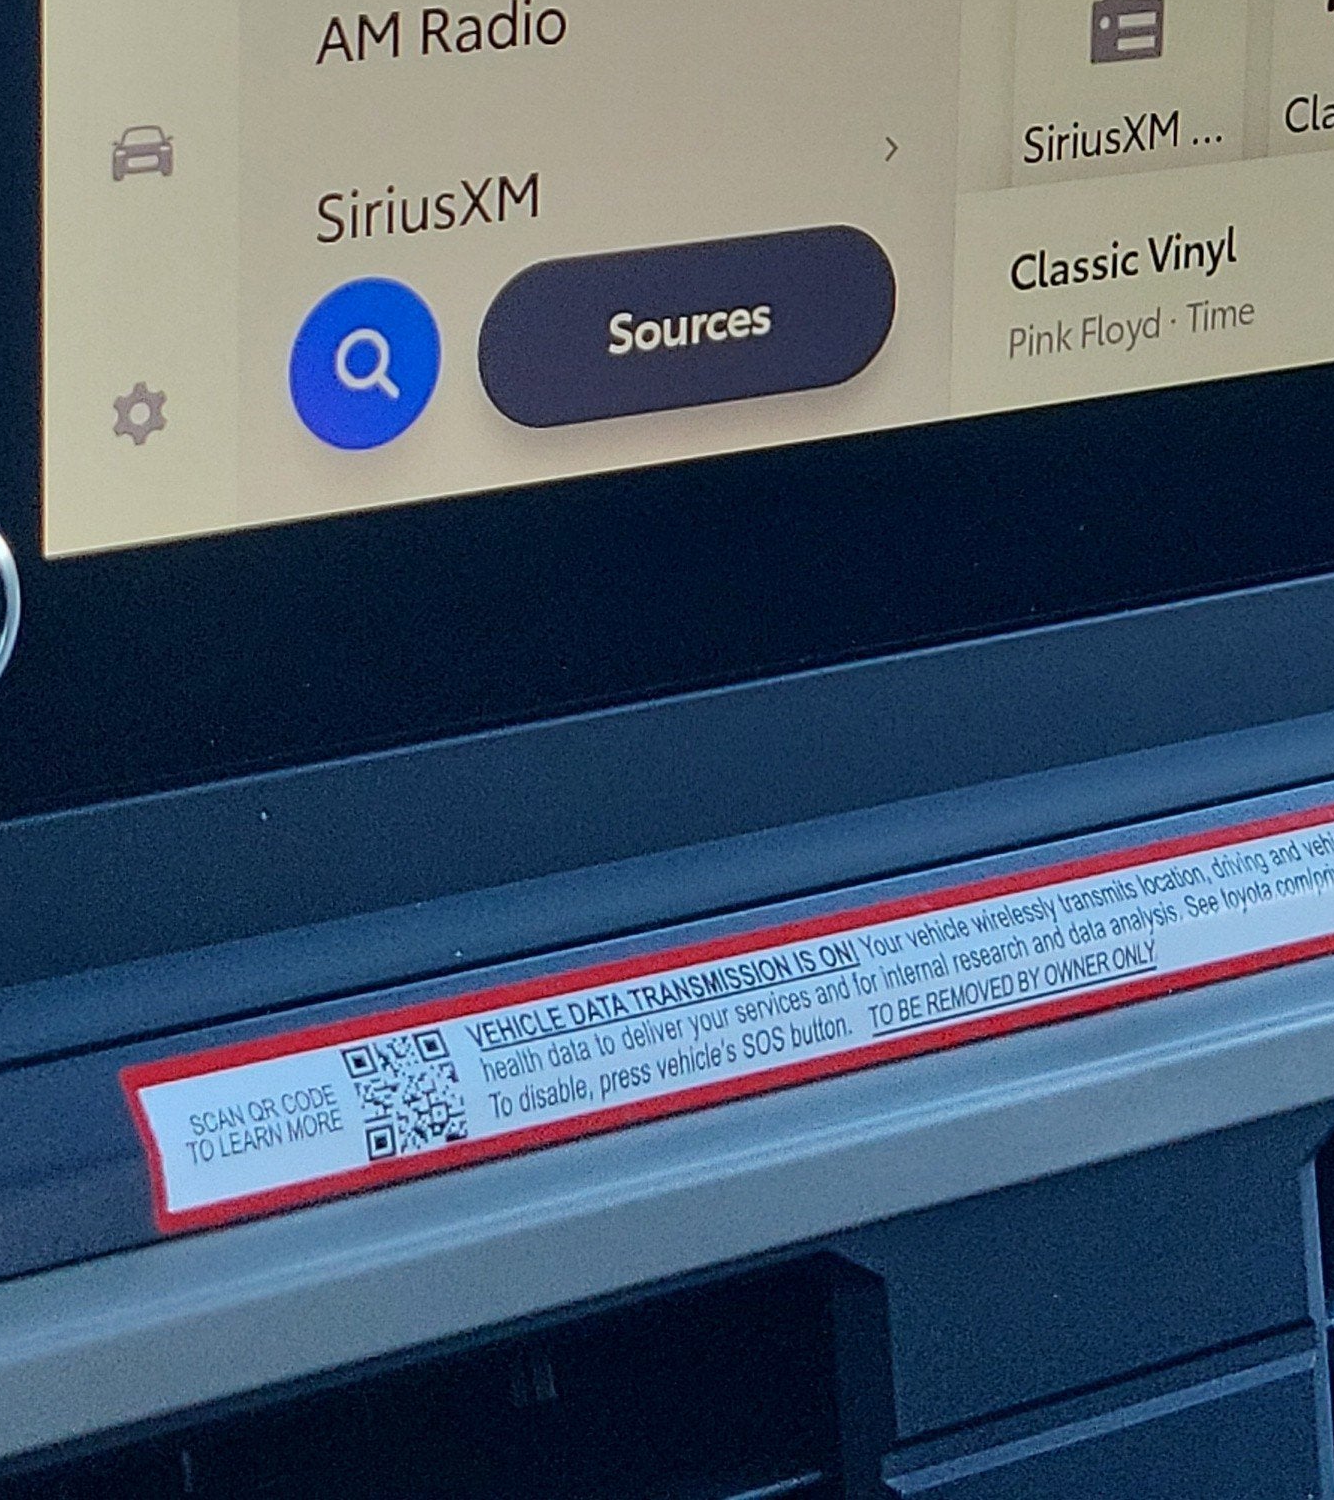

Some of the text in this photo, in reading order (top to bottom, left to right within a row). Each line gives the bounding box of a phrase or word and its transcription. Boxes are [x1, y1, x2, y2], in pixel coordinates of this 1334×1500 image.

[315, 9, 400, 66] AM
[1023, 110, 1180, 167] SiriusXM
[316, 172, 541, 245] SiriusXM
[1010, 225, 1239, 292] Classic Vinyl
[607, 302, 772, 358] Sources
[1008, 320, 1074, 361] Pink
[1080, 309, 1161, 351] Floyd
[1187, 300, 1256, 334] Time
[465, 1006, 566, 1048] VEHICLE
[568, 993, 629, 1026] DATA
[629, 952, 793, 1014] TRANSMISSION
[793, 949, 817, 974] IS
[819, 939, 861, 968] ON!
[858, 934, 904, 959] Your
[905, 917, 969, 947] vehicle
[970, 896, 1058, 934] wirelessly
[1057, 879, 1138, 914] transmits
[1135, 866, 1213, 897] location,
[1210, 851, 1270, 880] driving
[1269, 840, 1302, 867] and
[479, 1047, 544, 1083] health
[548, 1038, 592, 1068] data
[594, 1032, 616, 1057] to
[621, 1016, 684, 1051] deliver
[687, 1005, 730, 1042] your
[734, 987, 813, 1025] services
[815, 975, 851, 1006] and
[852, 970, 879, 996] for
[879, 952, 950, 990] internal
[952, 935, 1027, 974] research
[1032, 925, 1066, 954] and
[1068, 916, 1108, 946] data
[1109, 902, 1184, 936] analysis.
[1183, 894, 1219, 918] See
[868, 938, 1158, 1029] TO BE REMOVED BY OWNER ONLY
[488, 1015, 853, 1119] To disable, press vehicle's SOS button.
[185, 1107, 344, 1165] TO LEARN MORE
[189, 1083, 338, 1137] SCAN QR CODE
